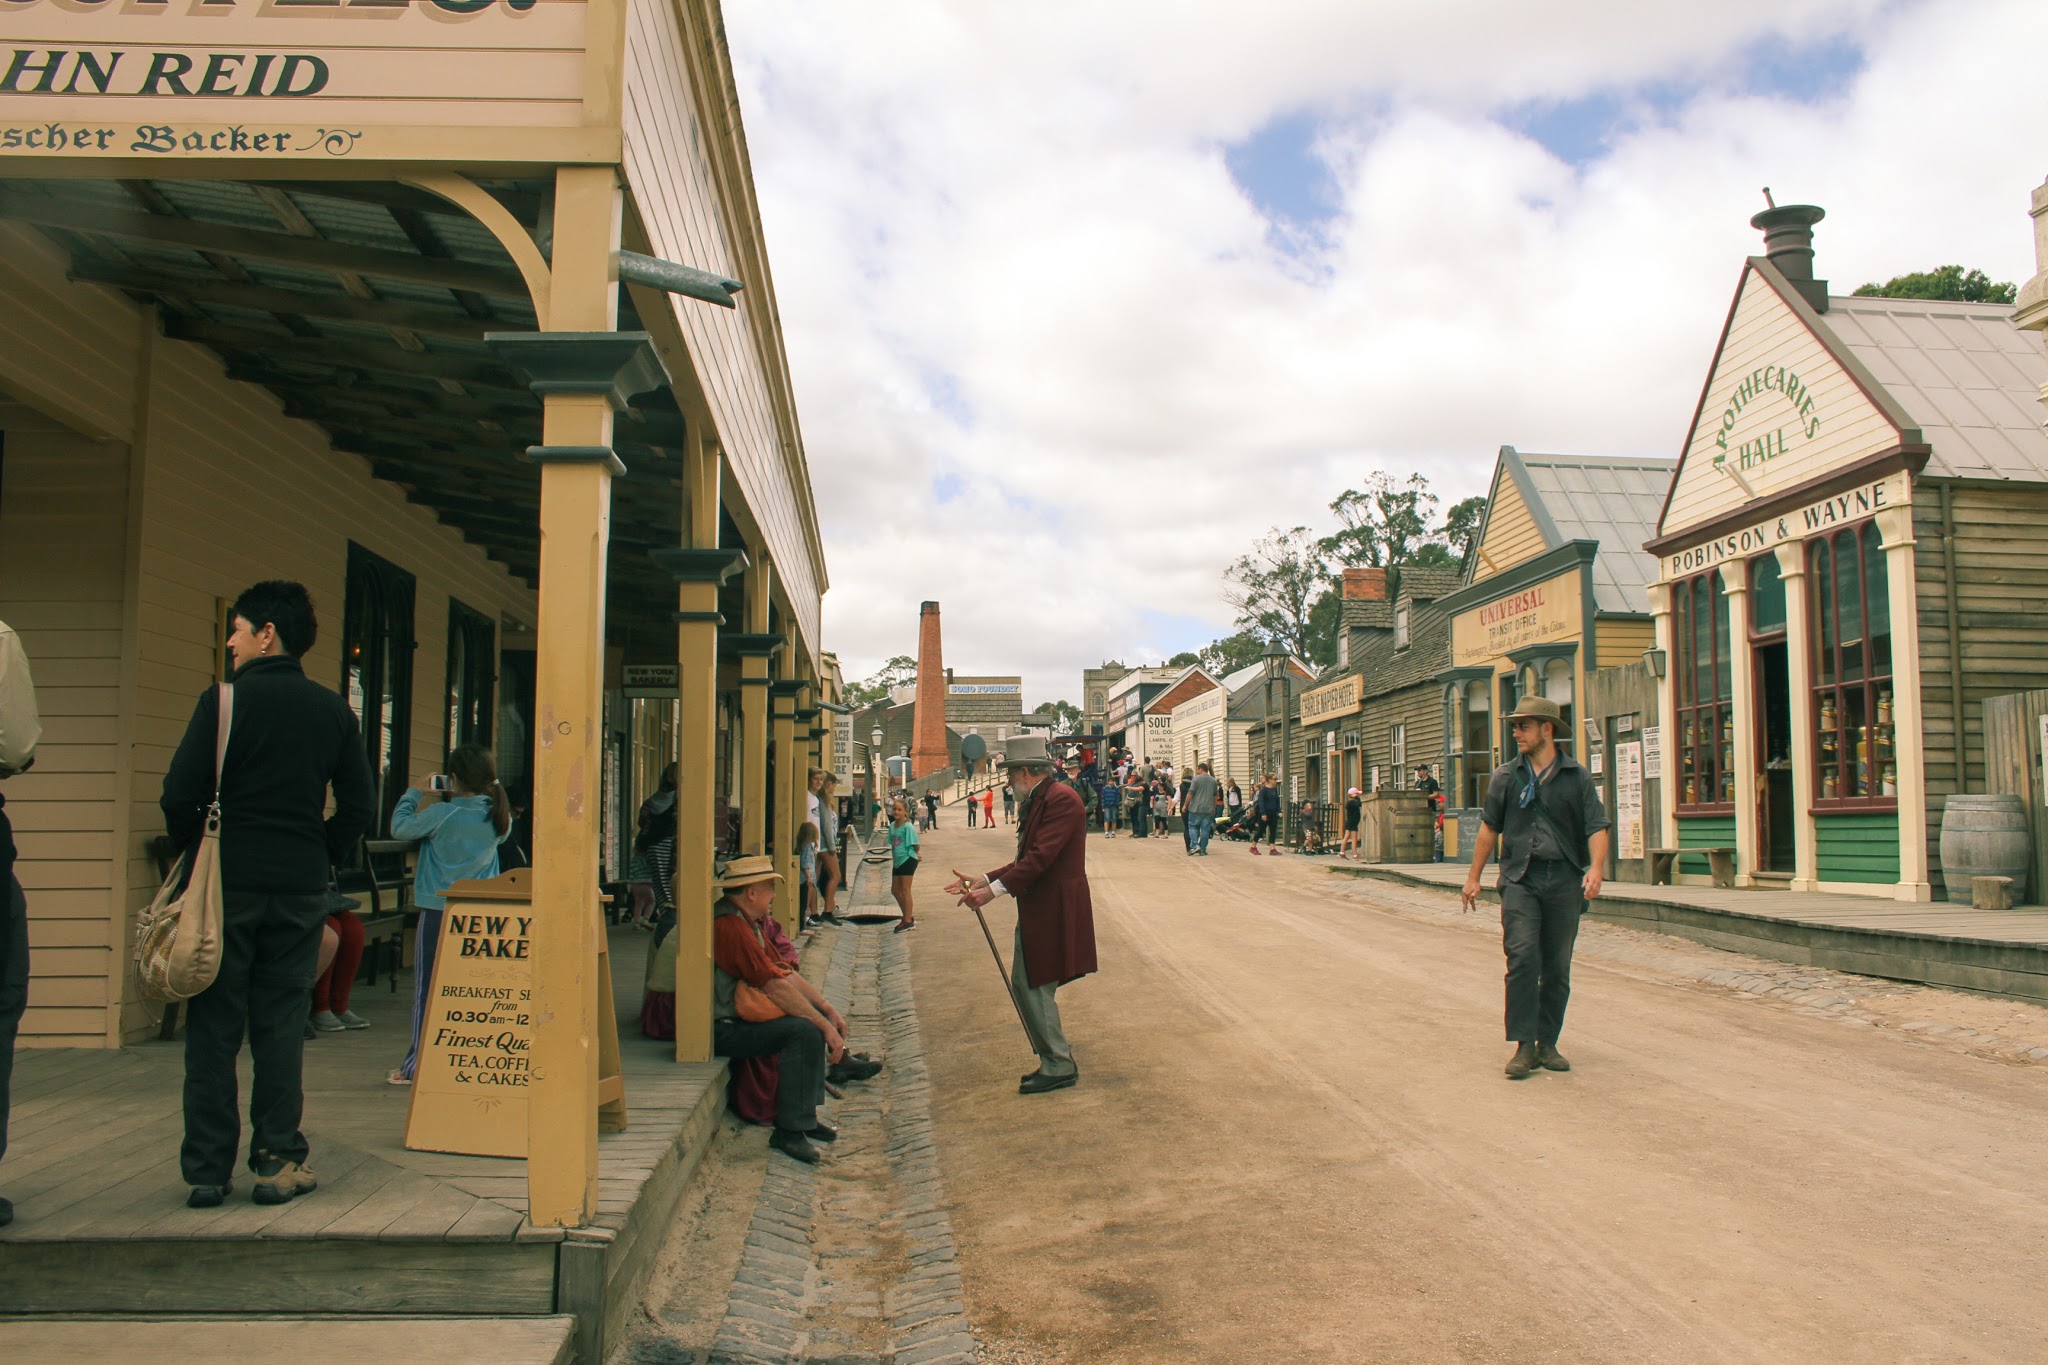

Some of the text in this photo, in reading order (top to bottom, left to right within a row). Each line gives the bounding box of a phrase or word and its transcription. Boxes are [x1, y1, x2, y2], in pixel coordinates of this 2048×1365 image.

[1, 50, 330, 97] HN REID
[131, 124, 292, 153] Backer
[1712, 365, 1820, 476] APOTHECARIES
[1739, 428, 1789, 471] HALL
[1672, 481, 1888, 575] ROBINSON & WAYNE
[1480, 587, 1545, 626] UNIVERSAL
[1489, 613, 1537, 639] TRANSIT OFFICE
[627, 667, 674, 676] NEW YORK
[1148, 717, 1171, 728] SOUT
[450, 914, 532, 936] NEW Y
[459, 937, 530, 959] BAKE
[441, 985, 514, 1000] BREAKFAST
[487, 1000, 518, 1015] from
[433, 1028, 494, 1048] Finest
[455, 1070, 529, 1086] & CAKES
